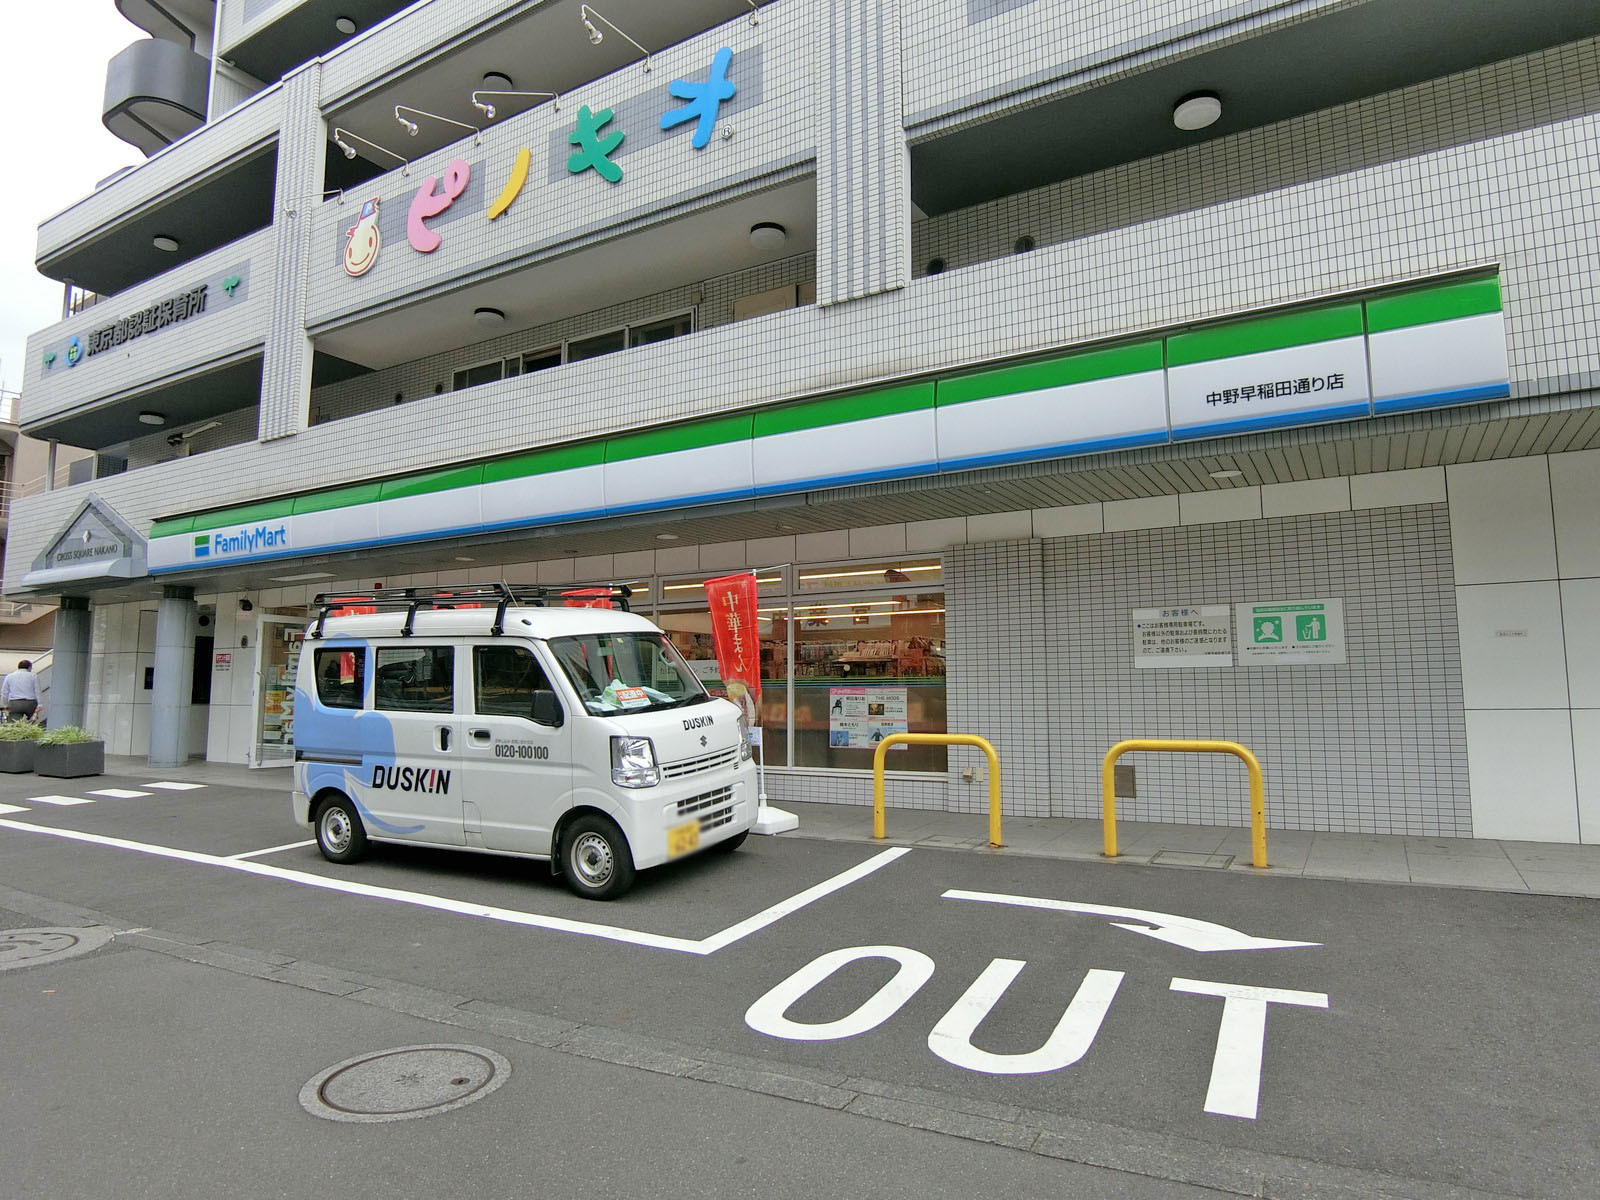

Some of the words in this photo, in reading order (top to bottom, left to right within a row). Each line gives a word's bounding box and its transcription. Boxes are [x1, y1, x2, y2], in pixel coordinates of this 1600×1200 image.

[407, 46, 737, 253] ピノキオ
[86, 283, 208, 357] 東京都認証保育所
[1205, 373, 1345, 407] 中野早稲田通り店
[214, 524, 286, 555] FamilyMart
[1161, 608, 1199, 617] お客様へ
[682, 714, 714, 732] DUSKIN
[495, 744, 549, 760] 0120-100100
[744, 945, 1329, 1119] OUT
